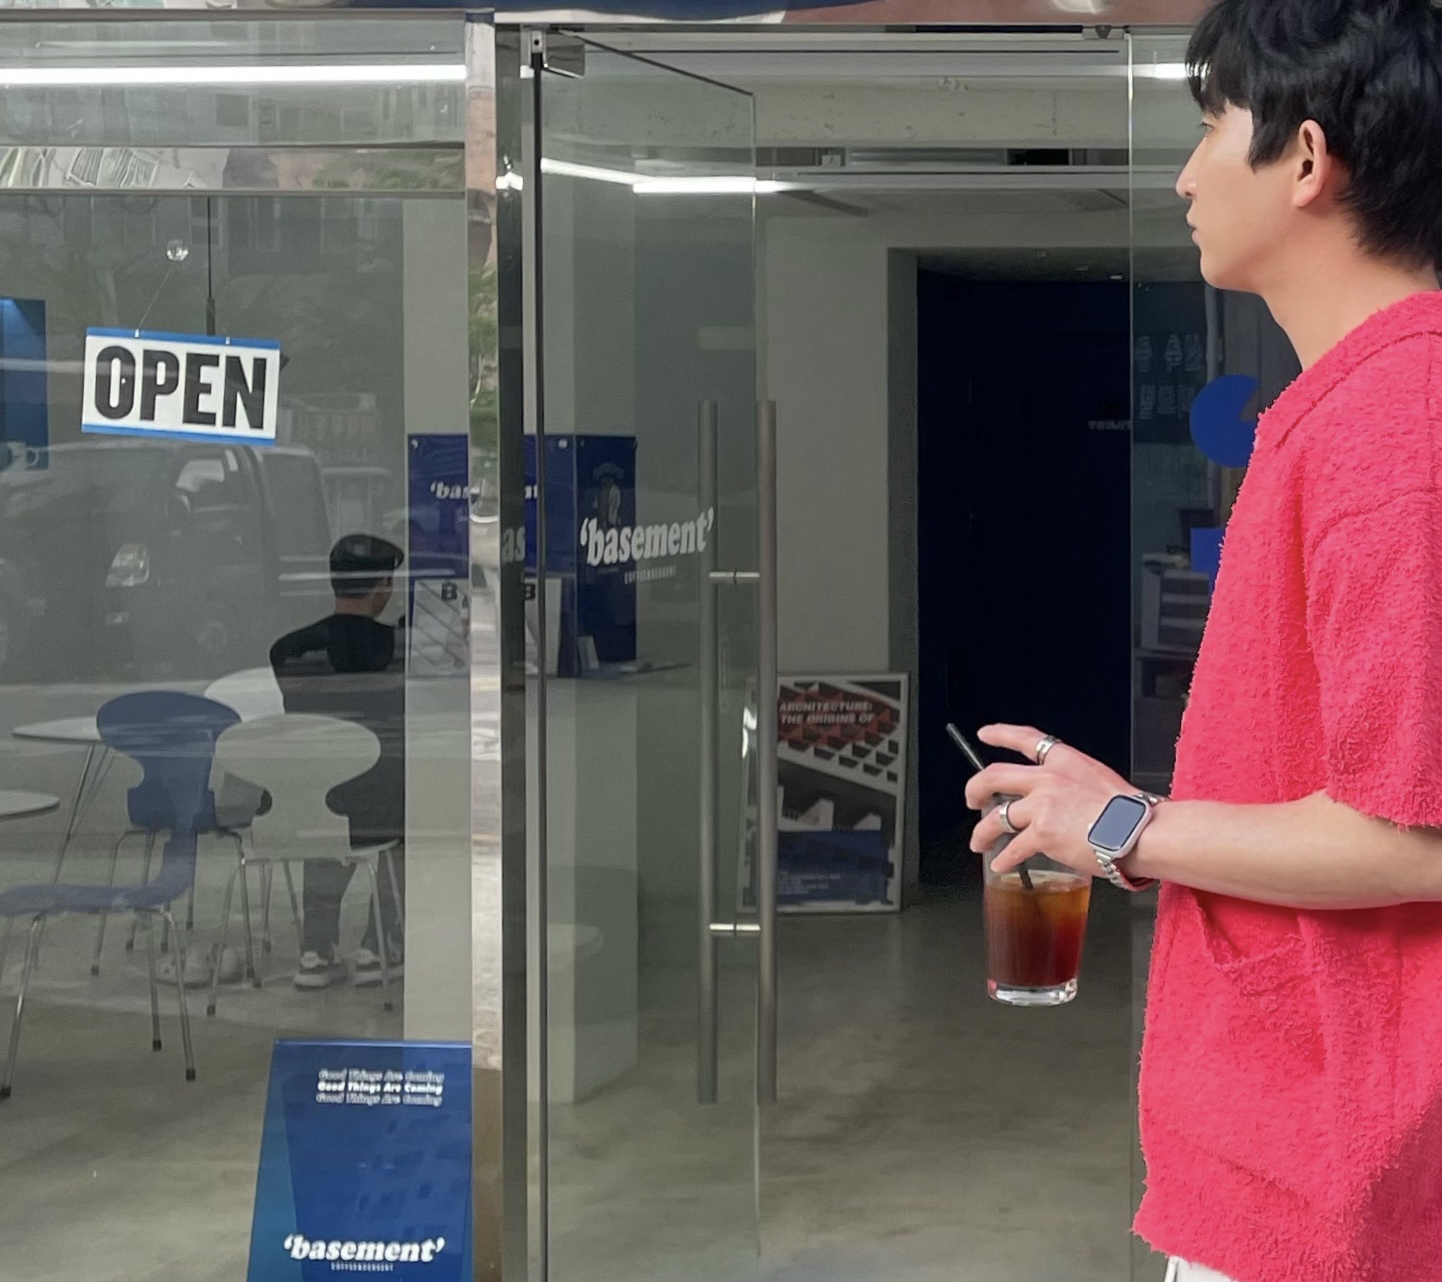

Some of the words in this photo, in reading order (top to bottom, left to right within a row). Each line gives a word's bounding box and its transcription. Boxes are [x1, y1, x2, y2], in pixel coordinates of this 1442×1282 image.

[94, 345, 268, 431] OPEN
[781, 713, 804, 724] THE
[858, 713, 876, 724] OF
[317, 1080, 346, 1092] Good
[347, 1081, 381, 1095] Things
[383, 1081, 401, 1093] Are
[404, 1082, 443, 1096] Coming
